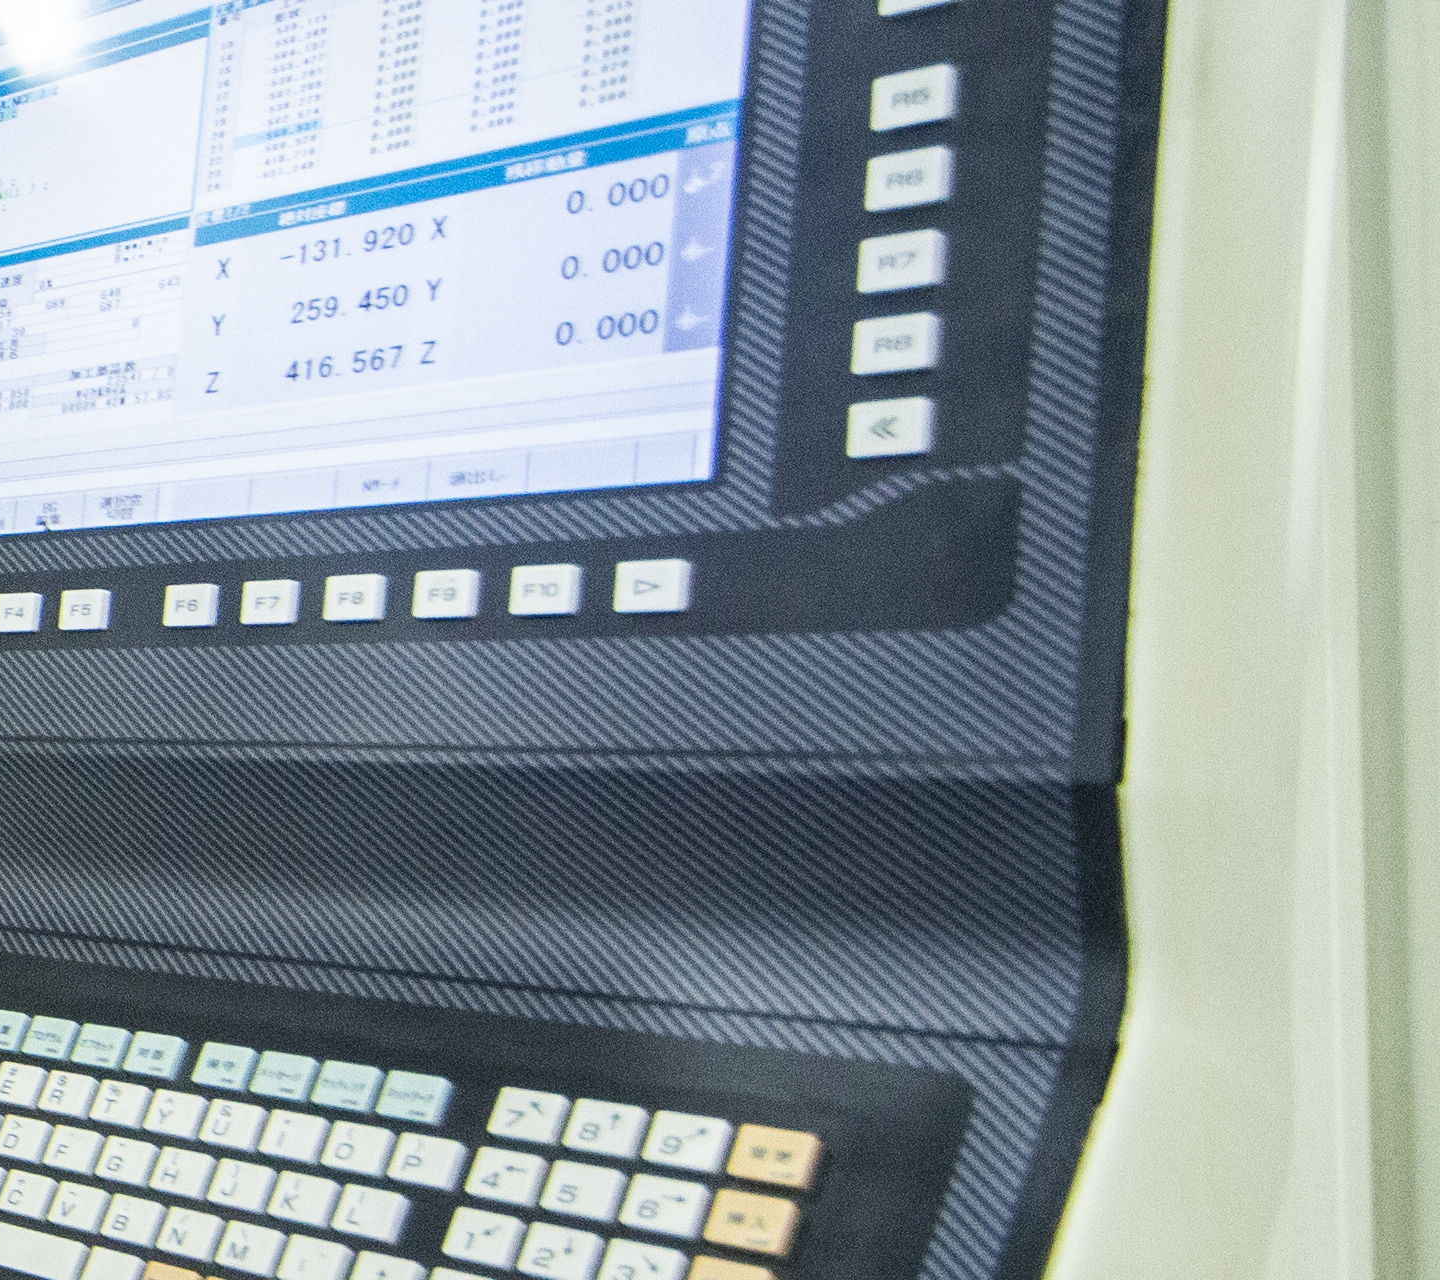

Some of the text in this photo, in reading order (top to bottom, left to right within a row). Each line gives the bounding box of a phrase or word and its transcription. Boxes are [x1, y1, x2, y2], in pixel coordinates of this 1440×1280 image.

[892, 86, 933, 109] R5
[214, 256, 232, 281] X
[429, 215, 449, 242] X
[878, 251, 920, 273] R7
[209, 313, 227, 337] Y
[424, 277, 444, 304] Y
[873, 332, 913, 355] R8
[203, 370, 221, 395] Z
[418, 339, 438, 366] Z
[338, 590, 365, 607] F8
[426, 586, 455, 604] F9
[522, 581, 559, 600] F10
[3, 605, 25, 620] F4
[68, 601, 92, 618] F5
[174, 596, 198, 613] F6
[254, 595, 280, 611] F7
[47, 1087, 65, 1105] R
[99, 1097, 117, 1114] T
[154, 1108, 173, 1125] Y
[501, 1108, 525, 1129] 7
[210, 1118, 231, 1137] U
[576, 1120, 601, 1142] 8
[2, 1132, 20, 1150] D
[658, 1134, 684, 1156] 9
[53, 1143, 68, 1160] F
[104, 1153, 124, 1172] G
[401, 1154, 423, 1173] P
[159, 1166, 179, 1183] H
[479, 1169, 502, 1188] 4
[5, 1187, 23, 1206] C
[218, 1178, 238, 1197] J
[555, 1182, 579, 1205] 5
[57, 1200, 75, 1218] V
[279, 1191, 298, 1210] K
[635, 1198, 661, 1221] 6
[110, 1213, 130, 1232] B
[344, 1206, 364, 1225] L
[166, 1226, 187, 1245] N
[225, 1241, 249, 1261] M
[531, 1245, 556, 1269] 2
